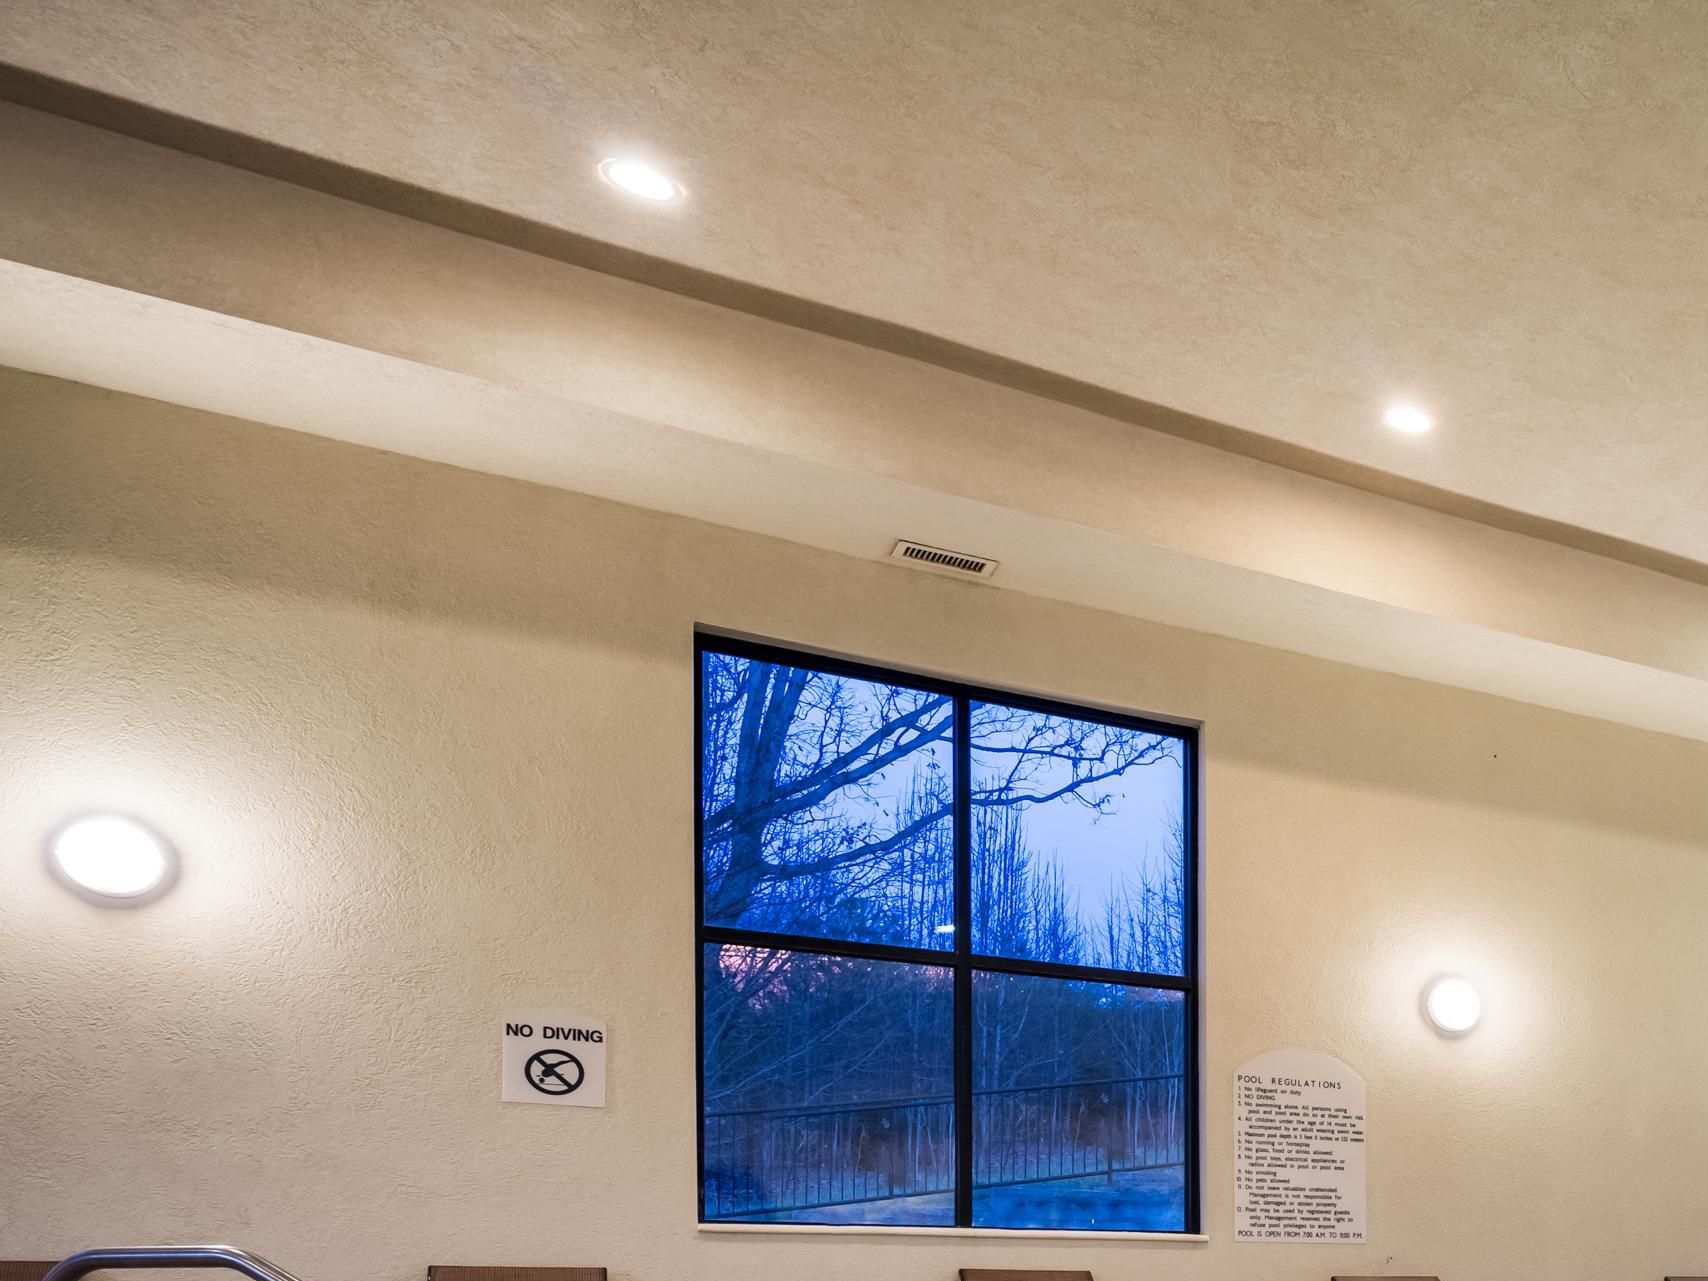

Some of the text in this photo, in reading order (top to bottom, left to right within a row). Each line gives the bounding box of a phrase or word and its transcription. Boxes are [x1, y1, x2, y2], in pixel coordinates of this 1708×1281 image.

[506, 1023, 603, 1043] NO DIVING
[1238, 1075, 1341, 1089] POOL REGULATIONS
